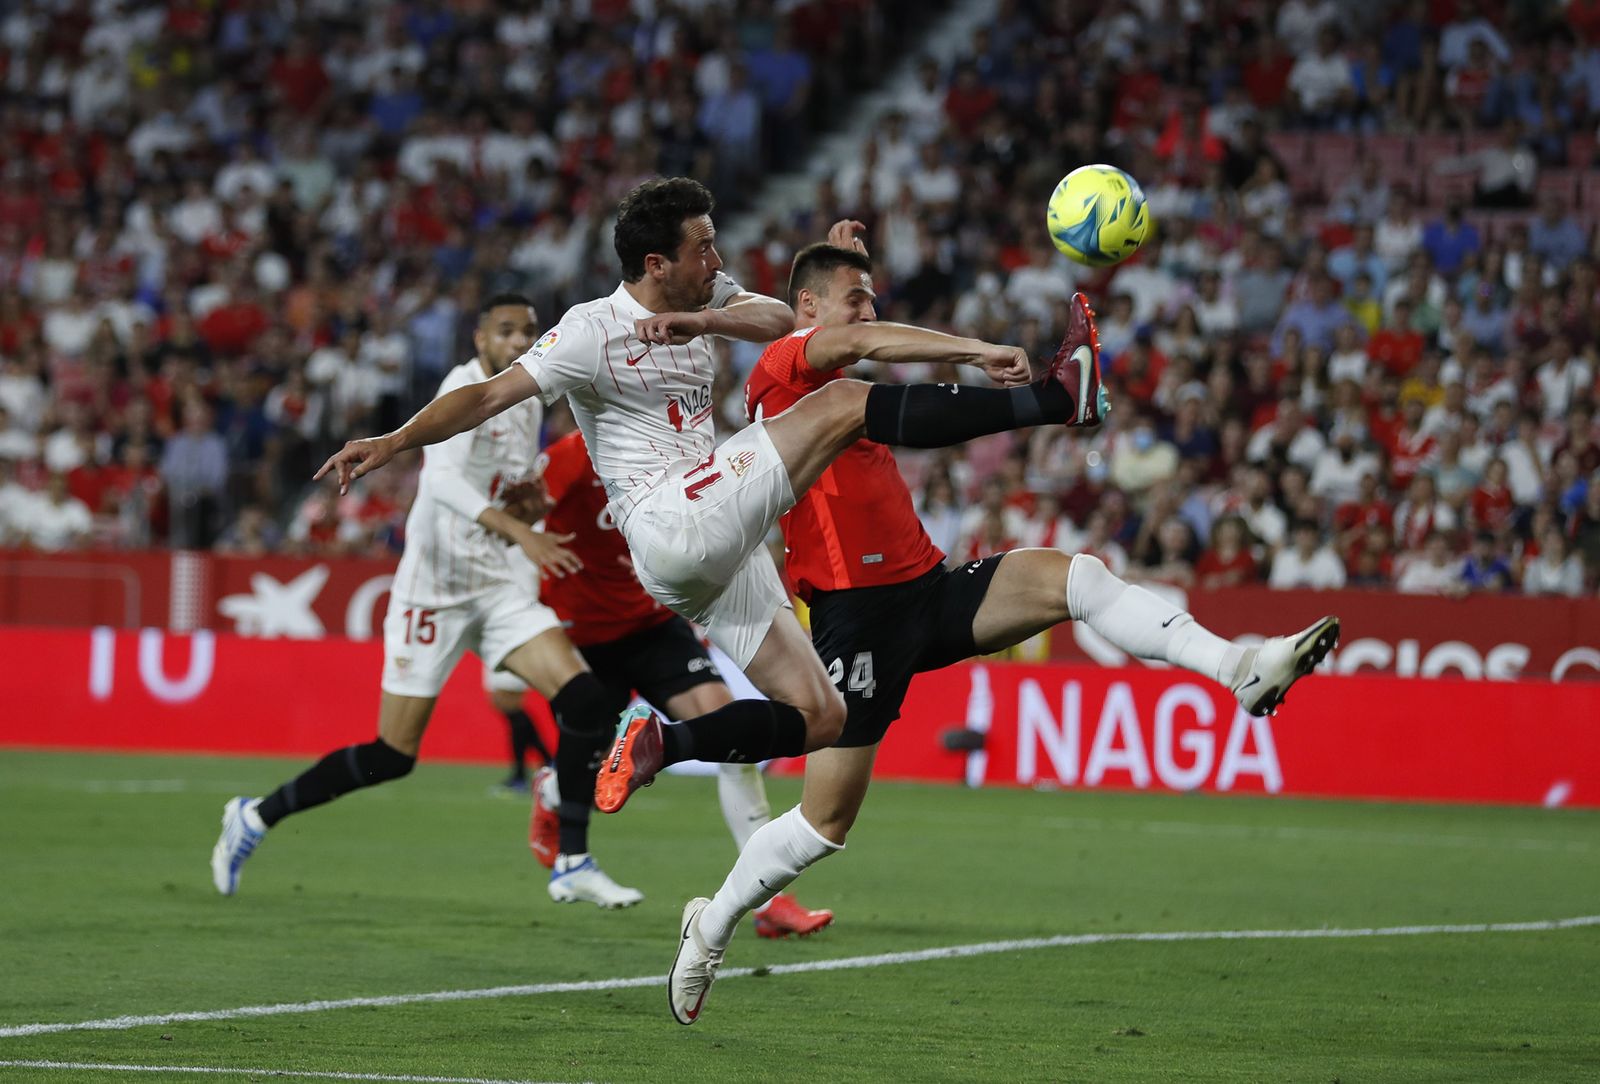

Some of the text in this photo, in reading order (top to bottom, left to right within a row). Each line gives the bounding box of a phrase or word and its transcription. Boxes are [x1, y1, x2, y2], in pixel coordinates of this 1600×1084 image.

[679, 384, 713, 416] NAG
[403, 608, 436, 645] 15
[1016, 679, 1284, 794] NAGA
